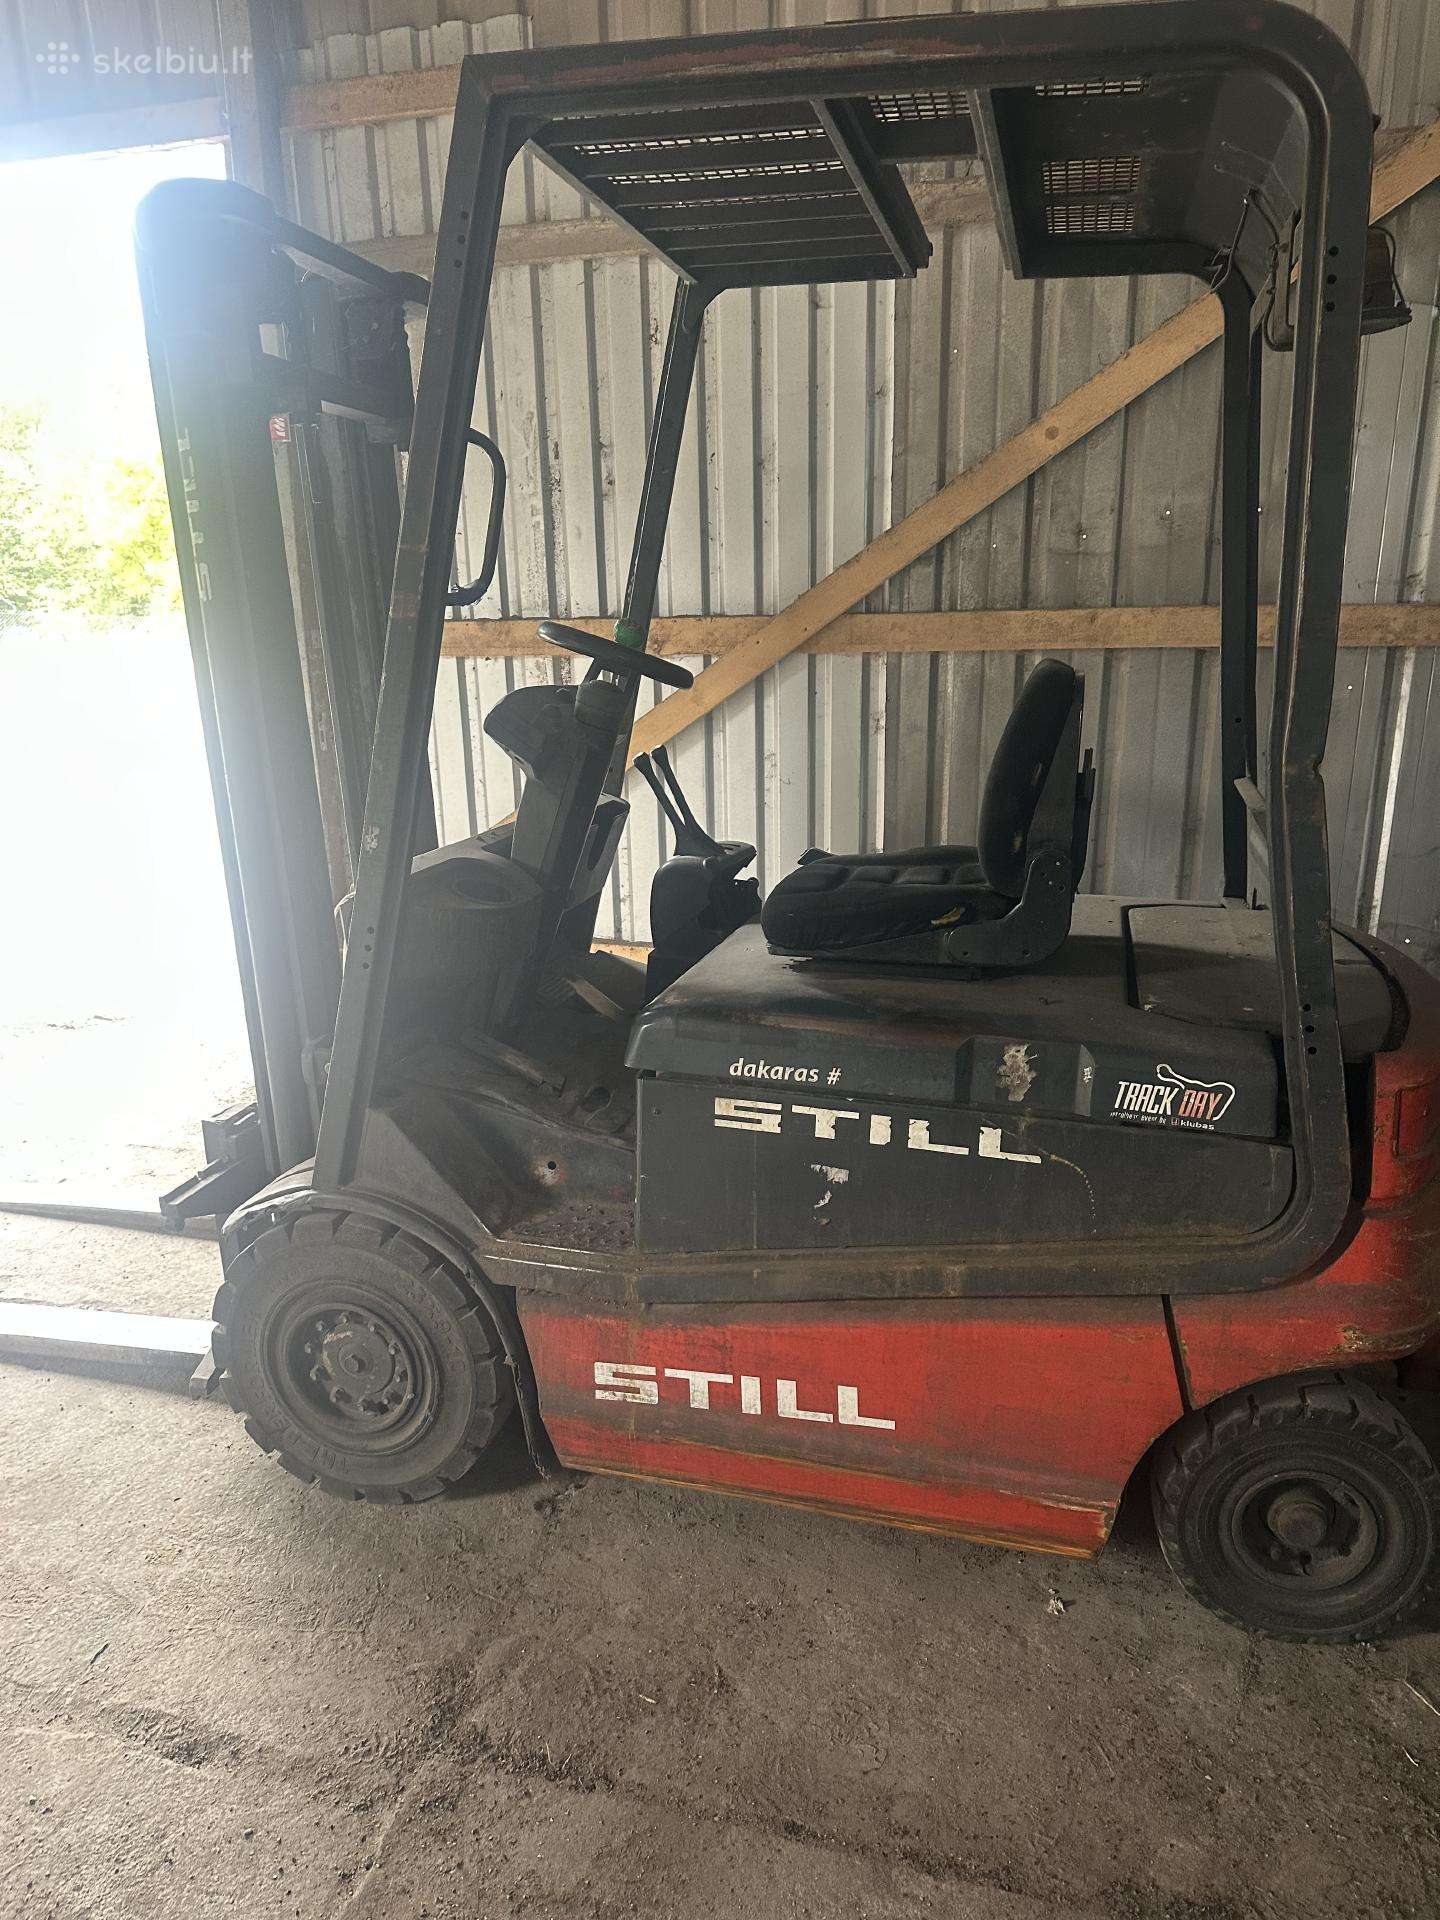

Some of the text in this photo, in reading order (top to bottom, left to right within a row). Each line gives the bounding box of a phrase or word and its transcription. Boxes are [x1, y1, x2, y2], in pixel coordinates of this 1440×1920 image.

[729, 1058, 841, 1085] dakaras #
[1114, 1081, 1223, 1120] TRACK DAY
[714, 1097, 1042, 1164] STILL
[1180, 1119, 1215, 1131] klubas
[594, 1361, 896, 1431] STILL
